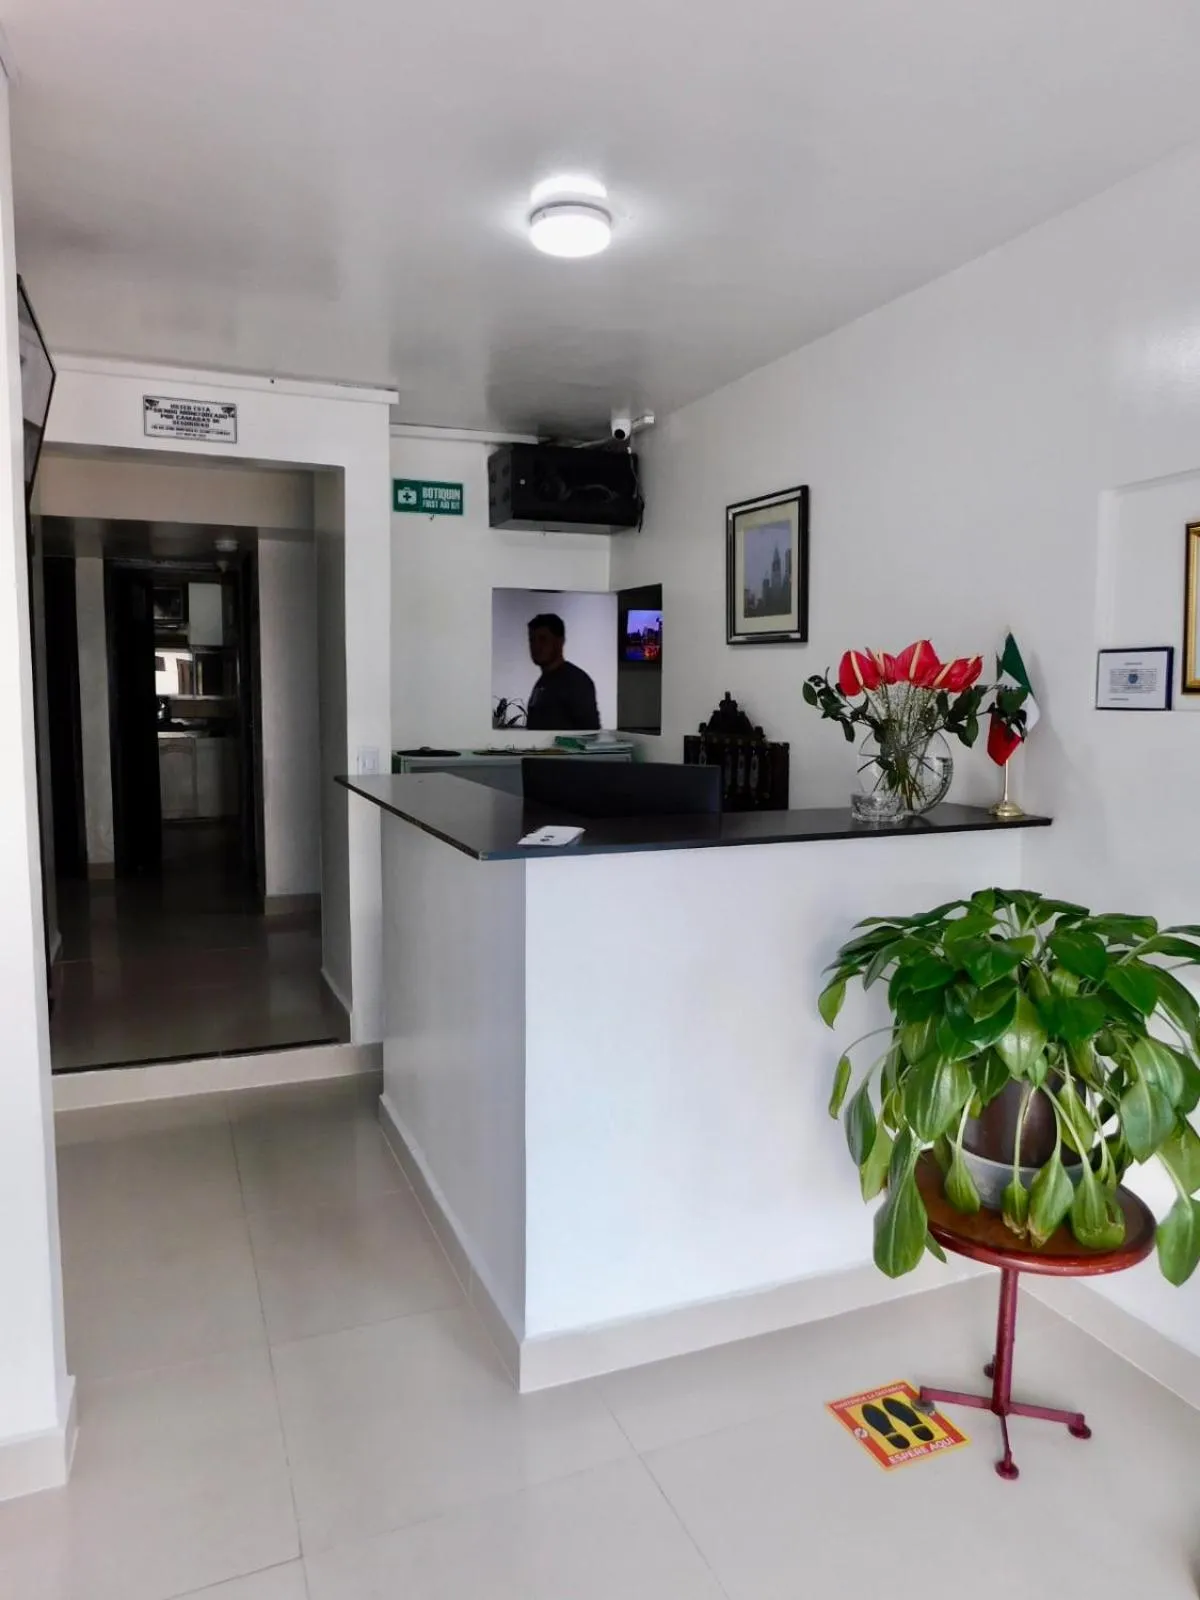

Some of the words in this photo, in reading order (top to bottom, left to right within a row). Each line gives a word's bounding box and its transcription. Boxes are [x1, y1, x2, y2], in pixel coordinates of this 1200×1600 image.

[422, 487, 461, 501] BOTIQUIN
[422, 499, 439, 509] FIRST
[440, 500, 450, 510] AID
[450, 501, 460, 510] KIT
[887, 1447, 929, 1465] ESPERE
